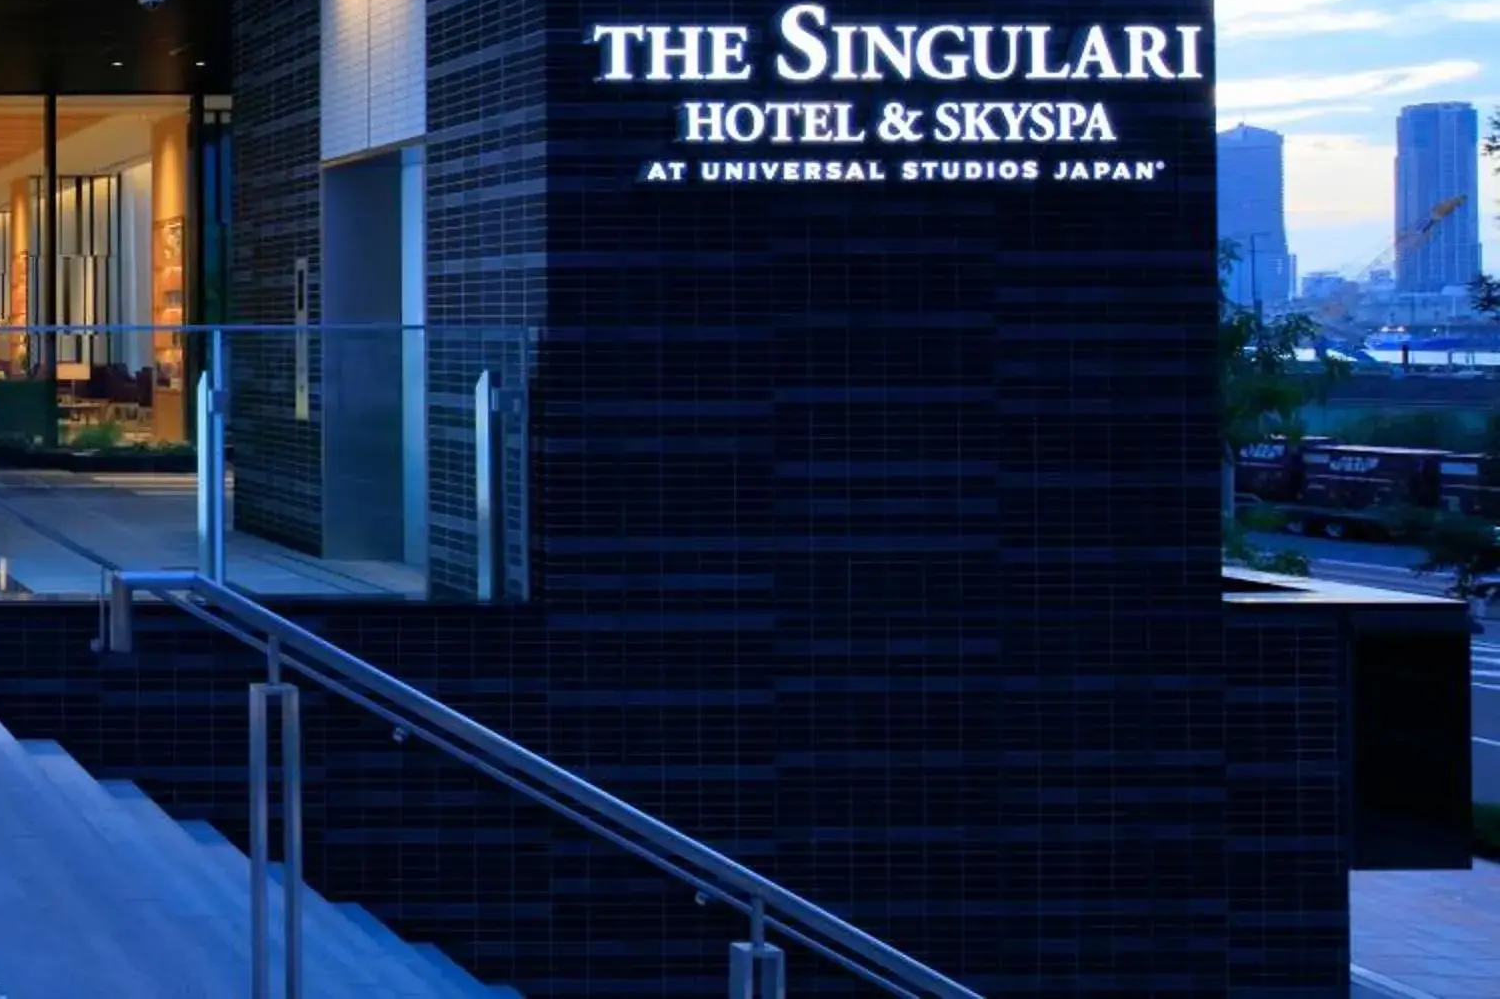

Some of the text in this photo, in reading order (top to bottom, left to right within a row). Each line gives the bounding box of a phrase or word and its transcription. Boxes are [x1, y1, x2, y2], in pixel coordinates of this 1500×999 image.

[592, 3, 1204, 81] THE SINGULARI
[684, 102, 1117, 142] HOTEL & SKYSPA
[647, 161, 686, 181] AT
[701, 161, 886, 181] UNIVERSAL
[902, 160, 1040, 180] STUDIOS
